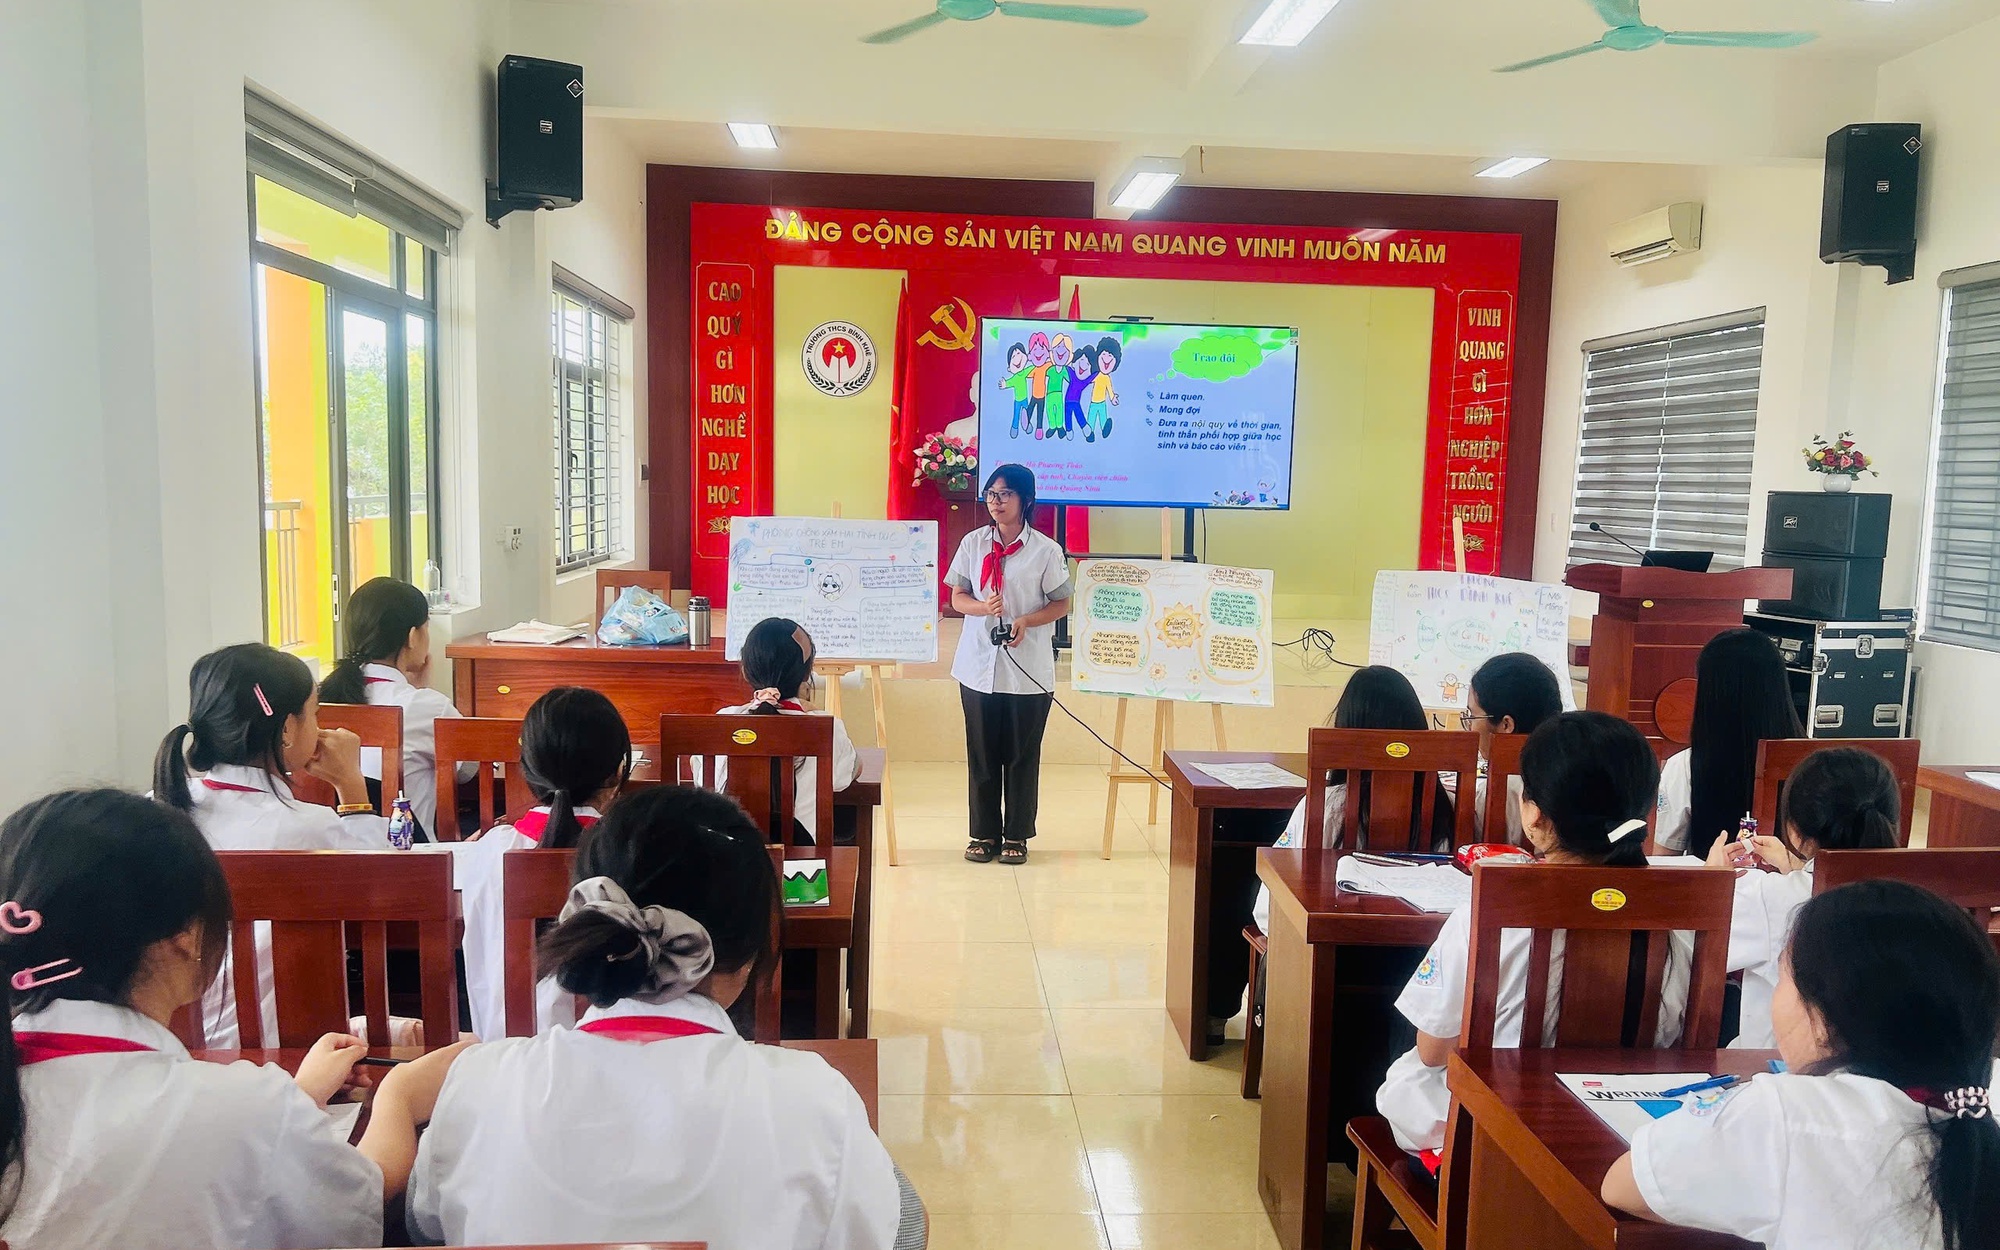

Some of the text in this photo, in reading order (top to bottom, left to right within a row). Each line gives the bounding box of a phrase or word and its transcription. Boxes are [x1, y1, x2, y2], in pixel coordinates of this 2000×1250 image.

[765, 212, 1446, 264] ĐẢNG CỘNG SẢN VIỆT NAM QUANG VINH MUÔN NĂM
[709, 281, 741, 301] CAO
[707, 311, 741, 338] QUÝ
[1467, 307, 1502, 327] VINH
[827, 325, 847, 333] THCS
[715, 346, 734, 370] GÌ
[1193, 352, 1217, 362] Trao
[1459, 340, 1505, 360] QUANG
[1472, 368, 1487, 393] GÌ
[710, 384, 746, 404] HƠN
[1160, 392, 1205, 402] Làm quen.
[1159, 405, 1201, 415] Mong đợi
[1464, 405, 1493, 426] HƠN
[701, 411, 747, 438] NGHỀ
[1158, 418, 1177, 427] Đưa
[1180, 420, 1189, 428] ra
[1191, 419, 1206, 429] nội
[1208, 421, 1225, 430] quy
[1157, 441, 1177, 450] sinh
[1191, 441, 1208, 450] báo
[1209, 441, 1226, 451] cáo
[1228, 441, 1247, 451] viên
[1222, 432, 1240, 442] hợp
[1265, 432, 1282, 442] học
[1450, 435, 1500, 464] NGHIỆP
[708, 452, 740, 476] DẠY
[1450, 465, 1494, 491] TRỒNG
[707, 485, 740, 510] HỌC
[1453, 499, 1493, 523] NGƯỜI
[1587, 1090, 1661, 1100] WRITIN
